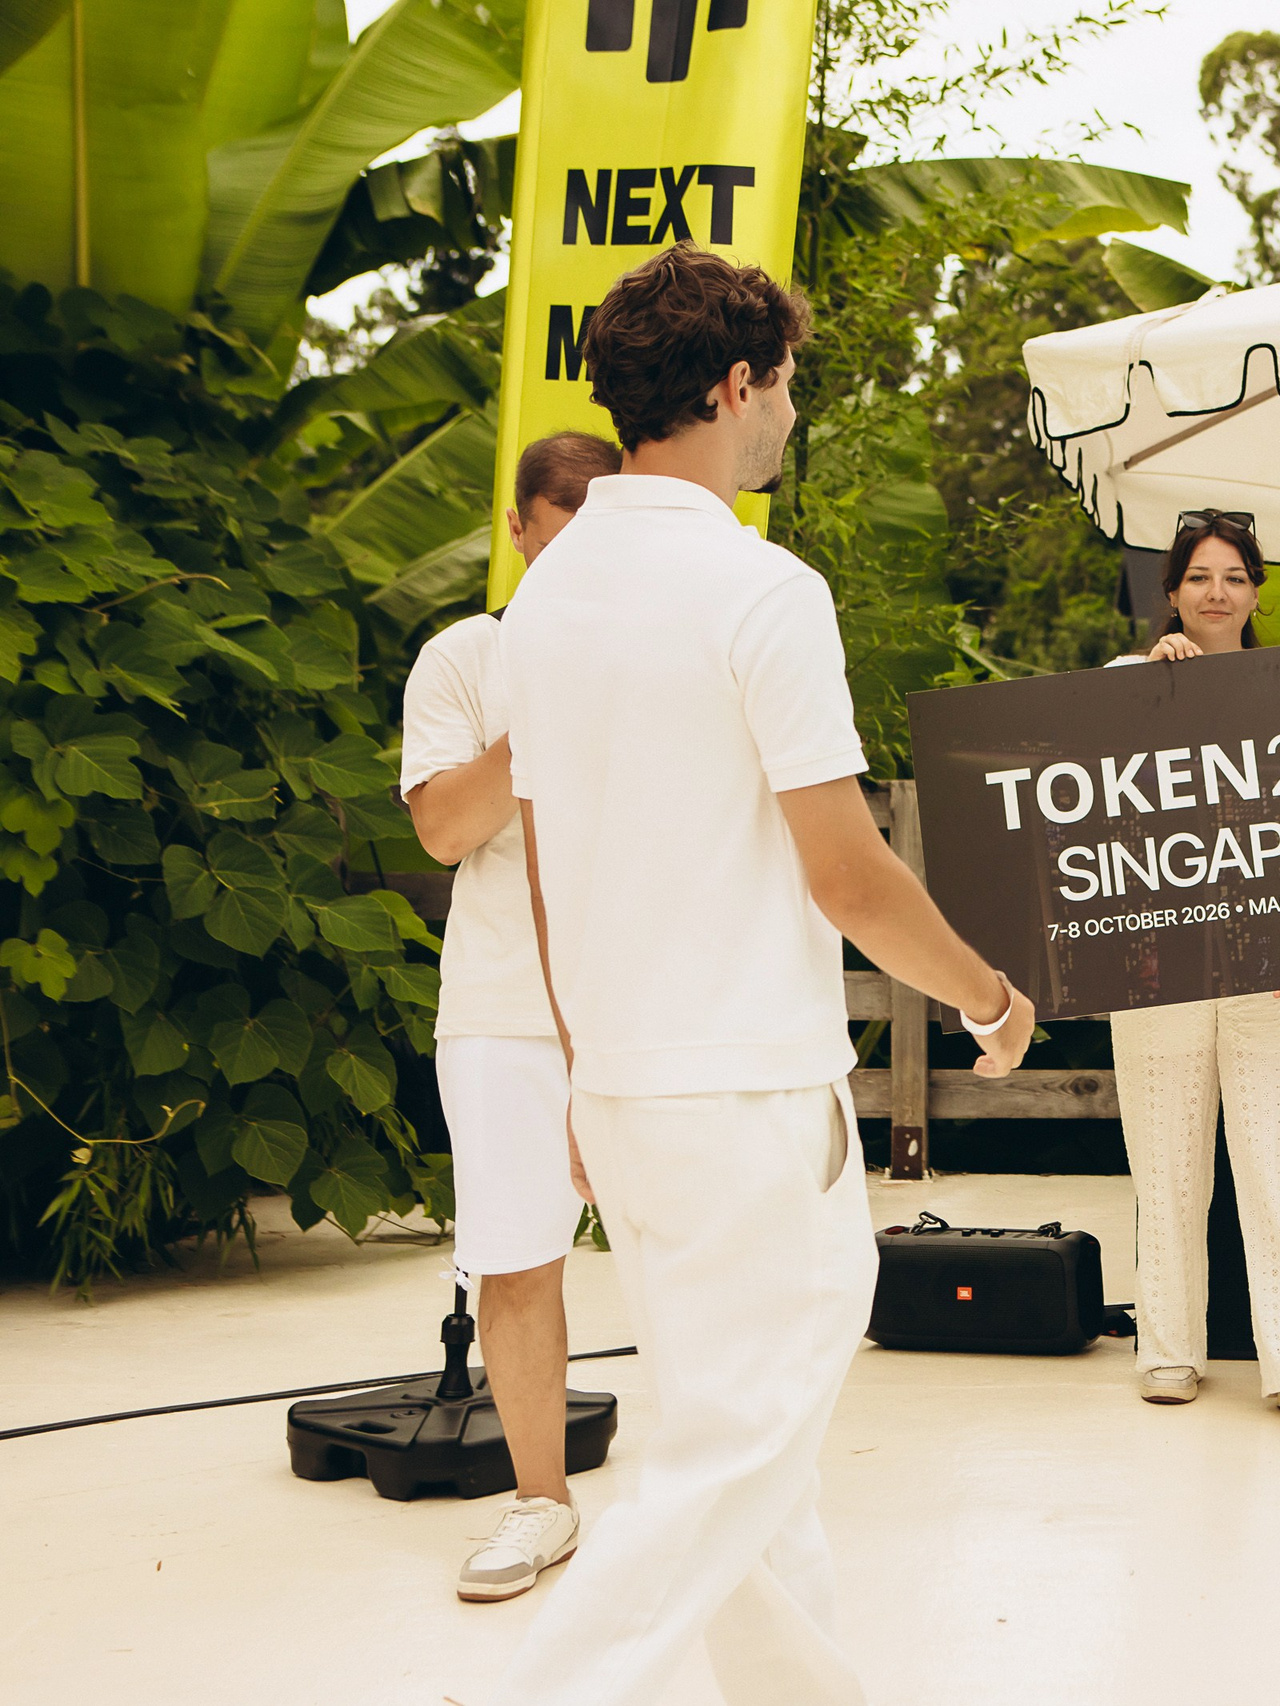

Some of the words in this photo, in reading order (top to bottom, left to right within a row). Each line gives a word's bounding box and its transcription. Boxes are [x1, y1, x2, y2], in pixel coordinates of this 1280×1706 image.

[562, 164, 755, 246] NEXT
[1047, 921, 1081, 941] 7-8
[1084, 907, 1178, 936] OCTOBER
[1181, 902, 1230, 925] 2026
